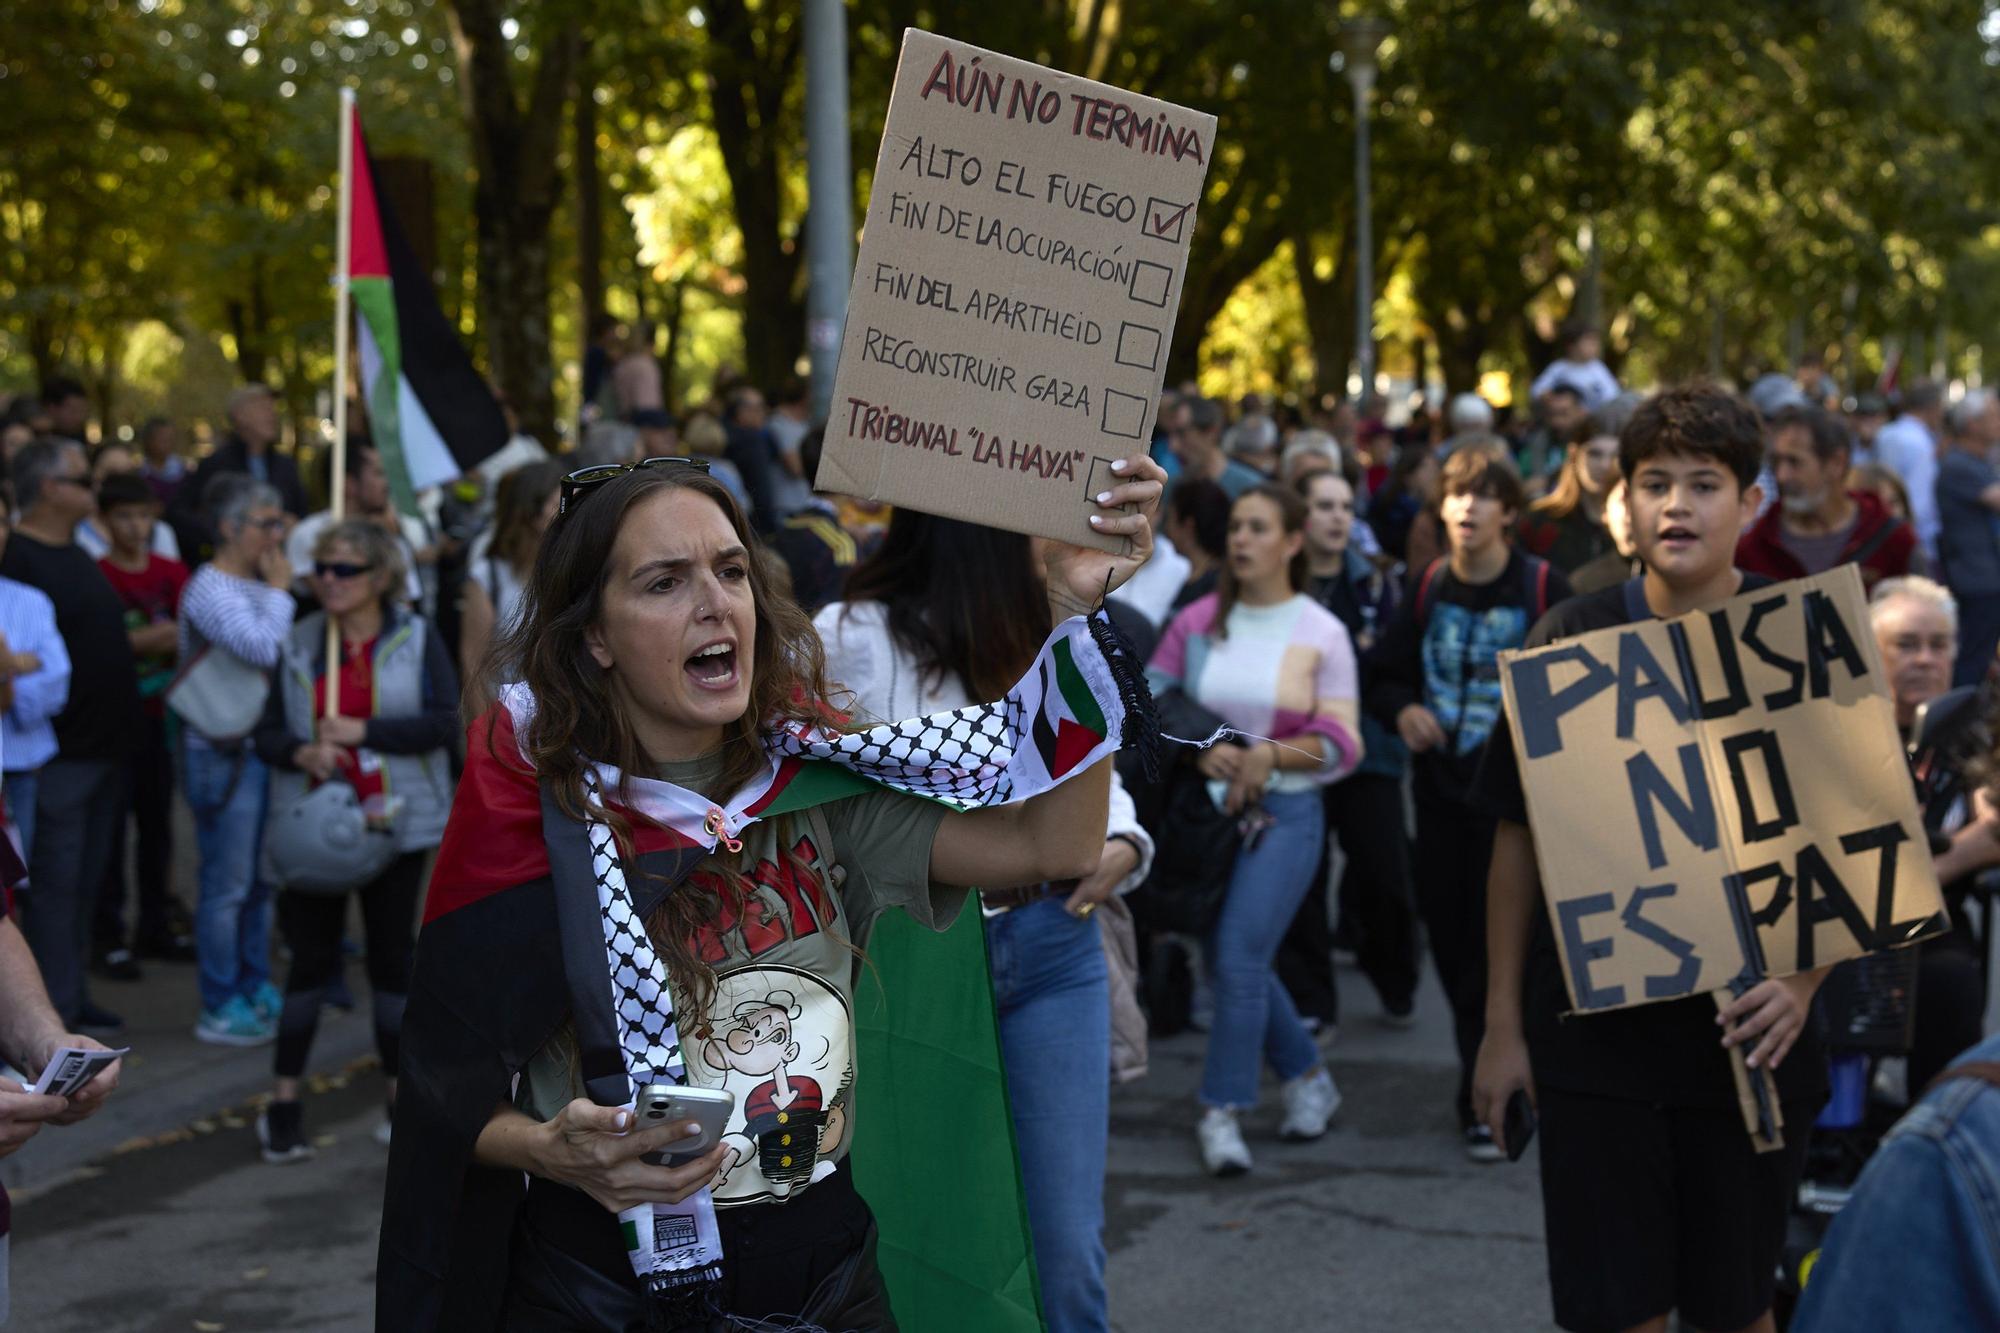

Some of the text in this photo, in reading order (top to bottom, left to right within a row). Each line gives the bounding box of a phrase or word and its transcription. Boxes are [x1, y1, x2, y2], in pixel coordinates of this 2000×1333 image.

[921, 50, 1004, 114] AÚN
[1007, 79, 1061, 123] NO
[900, 136, 1136, 223] ALTO EL FUEGO
[937, 206, 971, 239] DE
[976, 215, 1002, 250] LA
[916, 275, 959, 313] DEL
[1026, 375, 1090, 417] GAZA
[1510, 588, 1869, 760] PAUSA
[1625, 729, 1801, 871] NO
[1556, 821, 1946, 1011] ES PAZ
